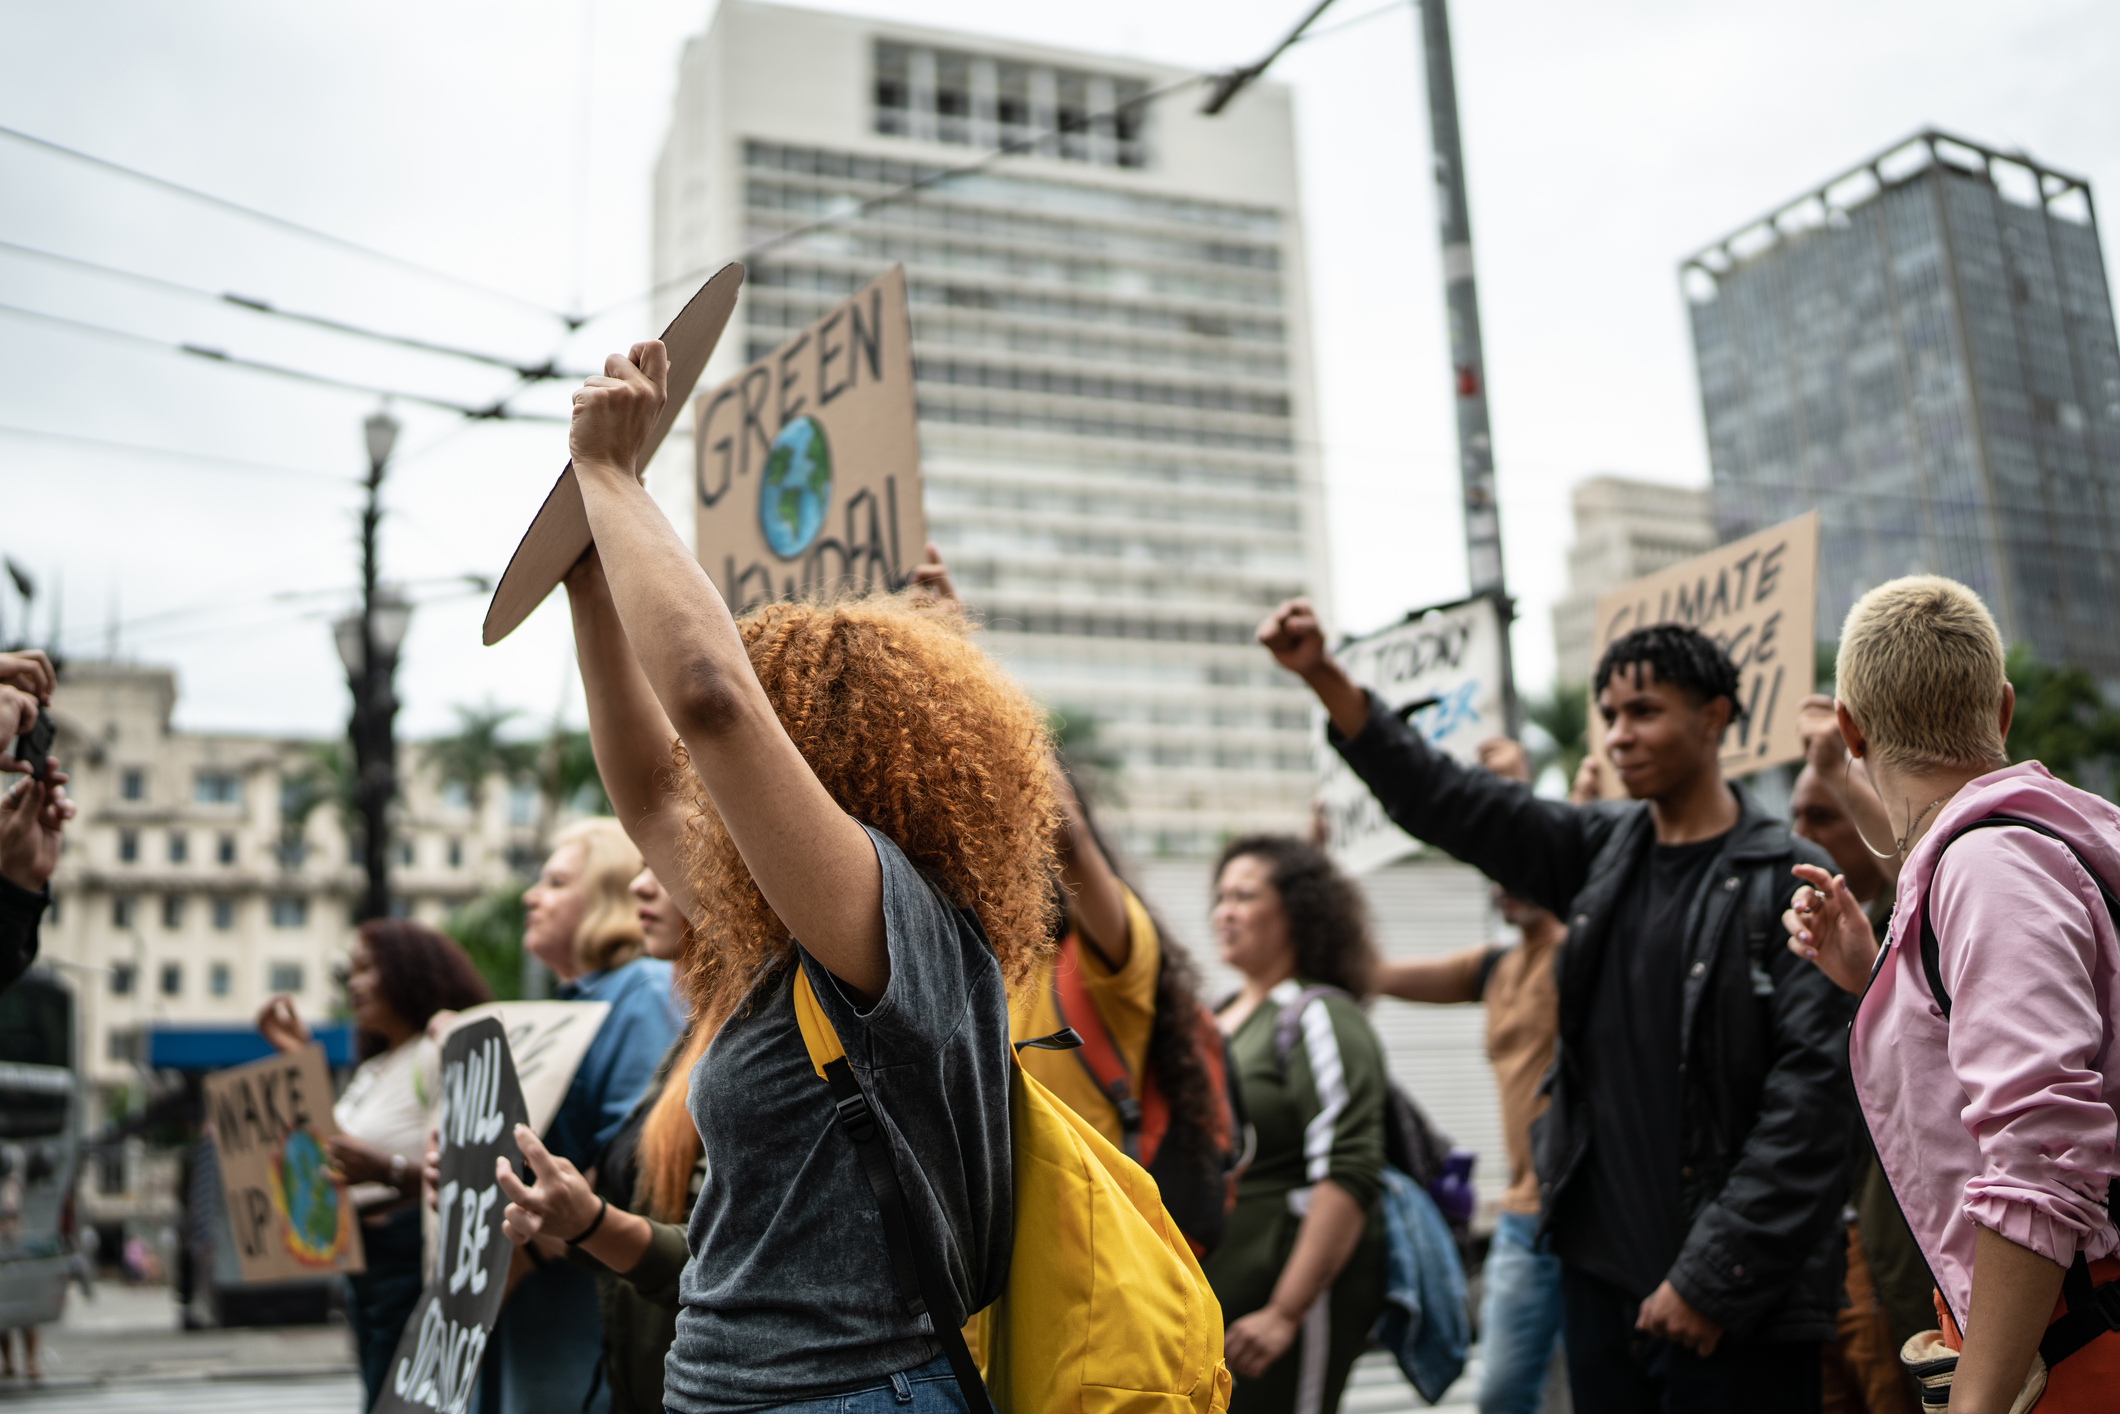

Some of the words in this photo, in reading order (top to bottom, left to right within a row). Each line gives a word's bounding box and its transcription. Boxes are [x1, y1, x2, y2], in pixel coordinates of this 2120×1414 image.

[697, 287, 882, 508] GREEN
[208, 1065, 311, 1157] WAKE
[229, 1184, 272, 1258] UP
[448, 1183, 498, 1296] BE
